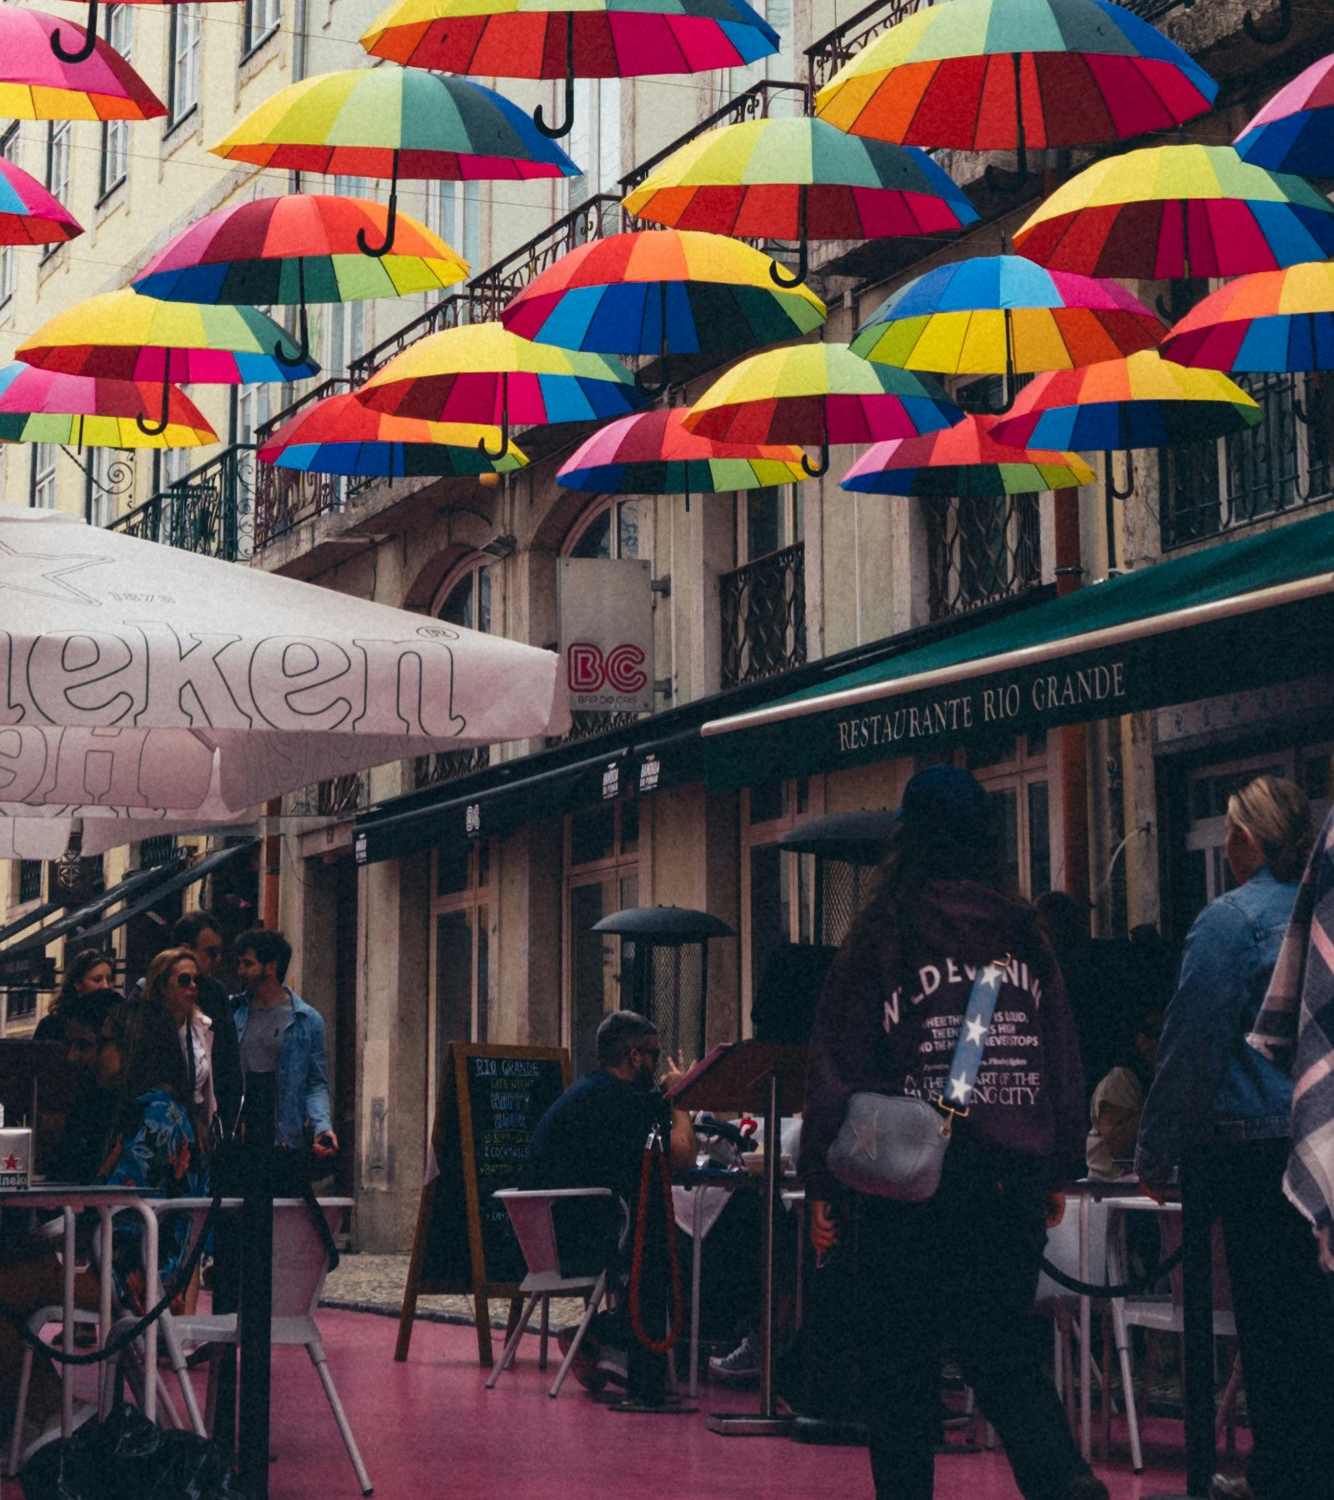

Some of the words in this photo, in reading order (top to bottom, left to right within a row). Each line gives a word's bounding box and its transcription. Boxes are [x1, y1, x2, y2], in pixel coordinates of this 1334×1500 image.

[568, 642, 648, 694] BC
[837, 695, 974, 753] RESTAURANTE
[982, 684, 1021, 723] RIO
[1032, 661, 1127, 713] GRANDE
[999, 1086, 1041, 1106] CITY
[1013, 1072, 1041, 1085] THE
